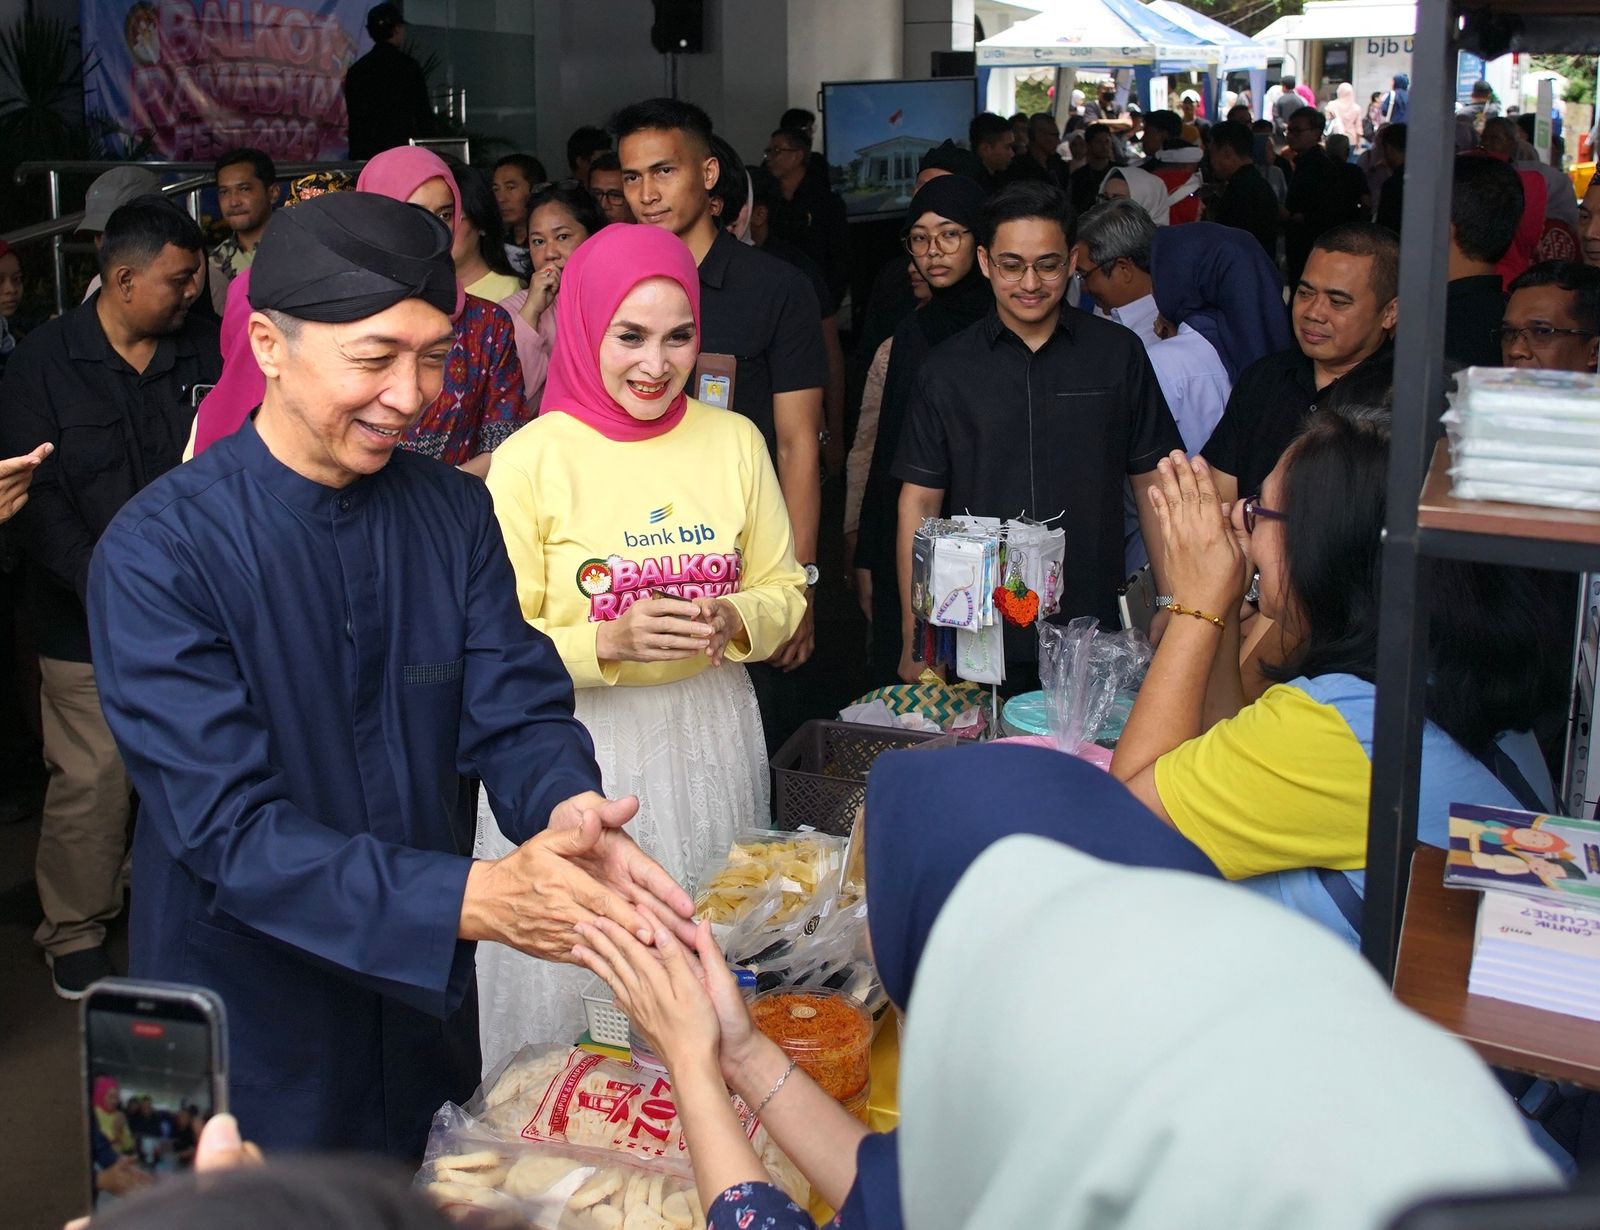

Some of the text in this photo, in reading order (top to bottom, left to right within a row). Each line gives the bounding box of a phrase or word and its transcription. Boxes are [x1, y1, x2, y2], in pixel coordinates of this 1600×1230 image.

[1367, 39, 1399, 57] bjb
[624, 523, 716, 547] bank bjb
[1534, 920, 1592, 937] CANTIK
[553, 1091, 571, 1125] KERUPUK
[628, 1077, 678, 1142] 707
